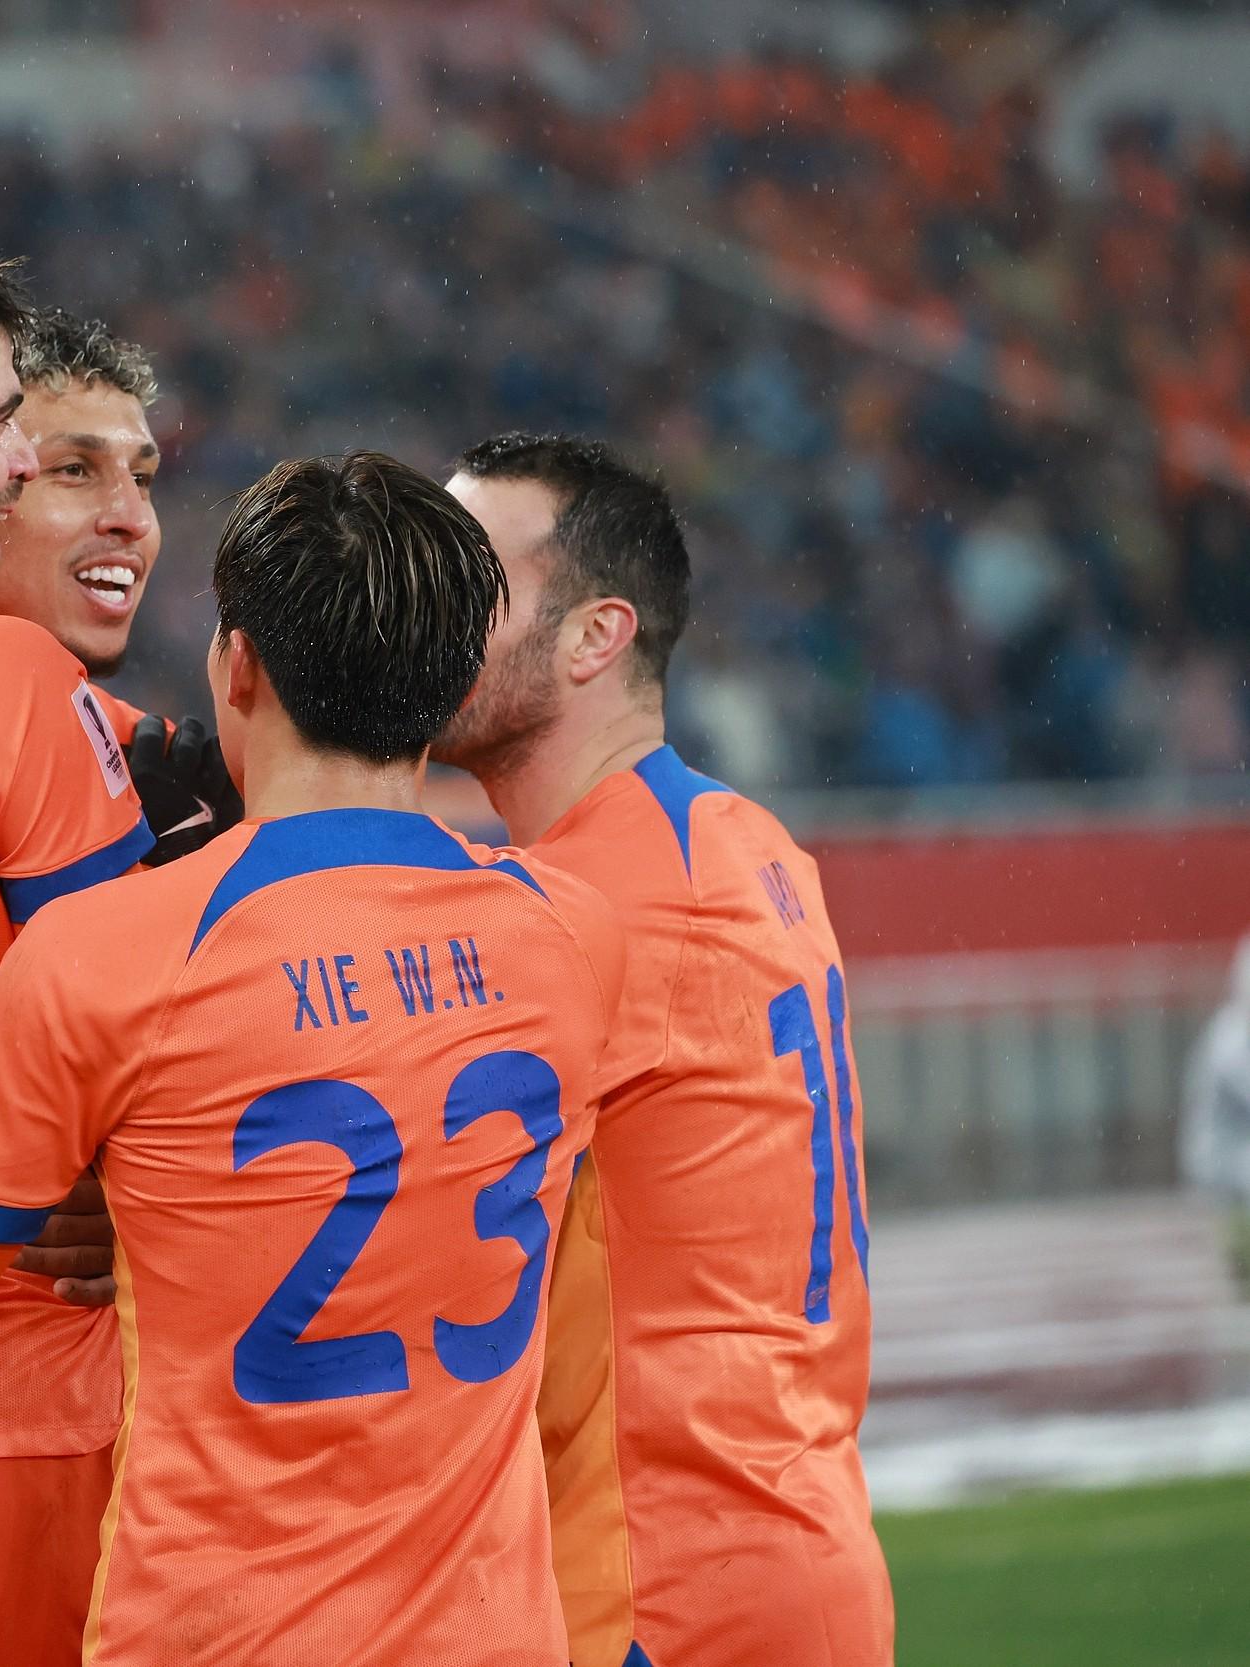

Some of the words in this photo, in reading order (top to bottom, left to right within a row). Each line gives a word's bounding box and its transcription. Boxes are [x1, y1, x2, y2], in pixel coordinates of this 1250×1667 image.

[282, 955, 369, 1031] XIE
[385, 938, 505, 1016] W.N.
[233, 1050, 563, 1404] 23
